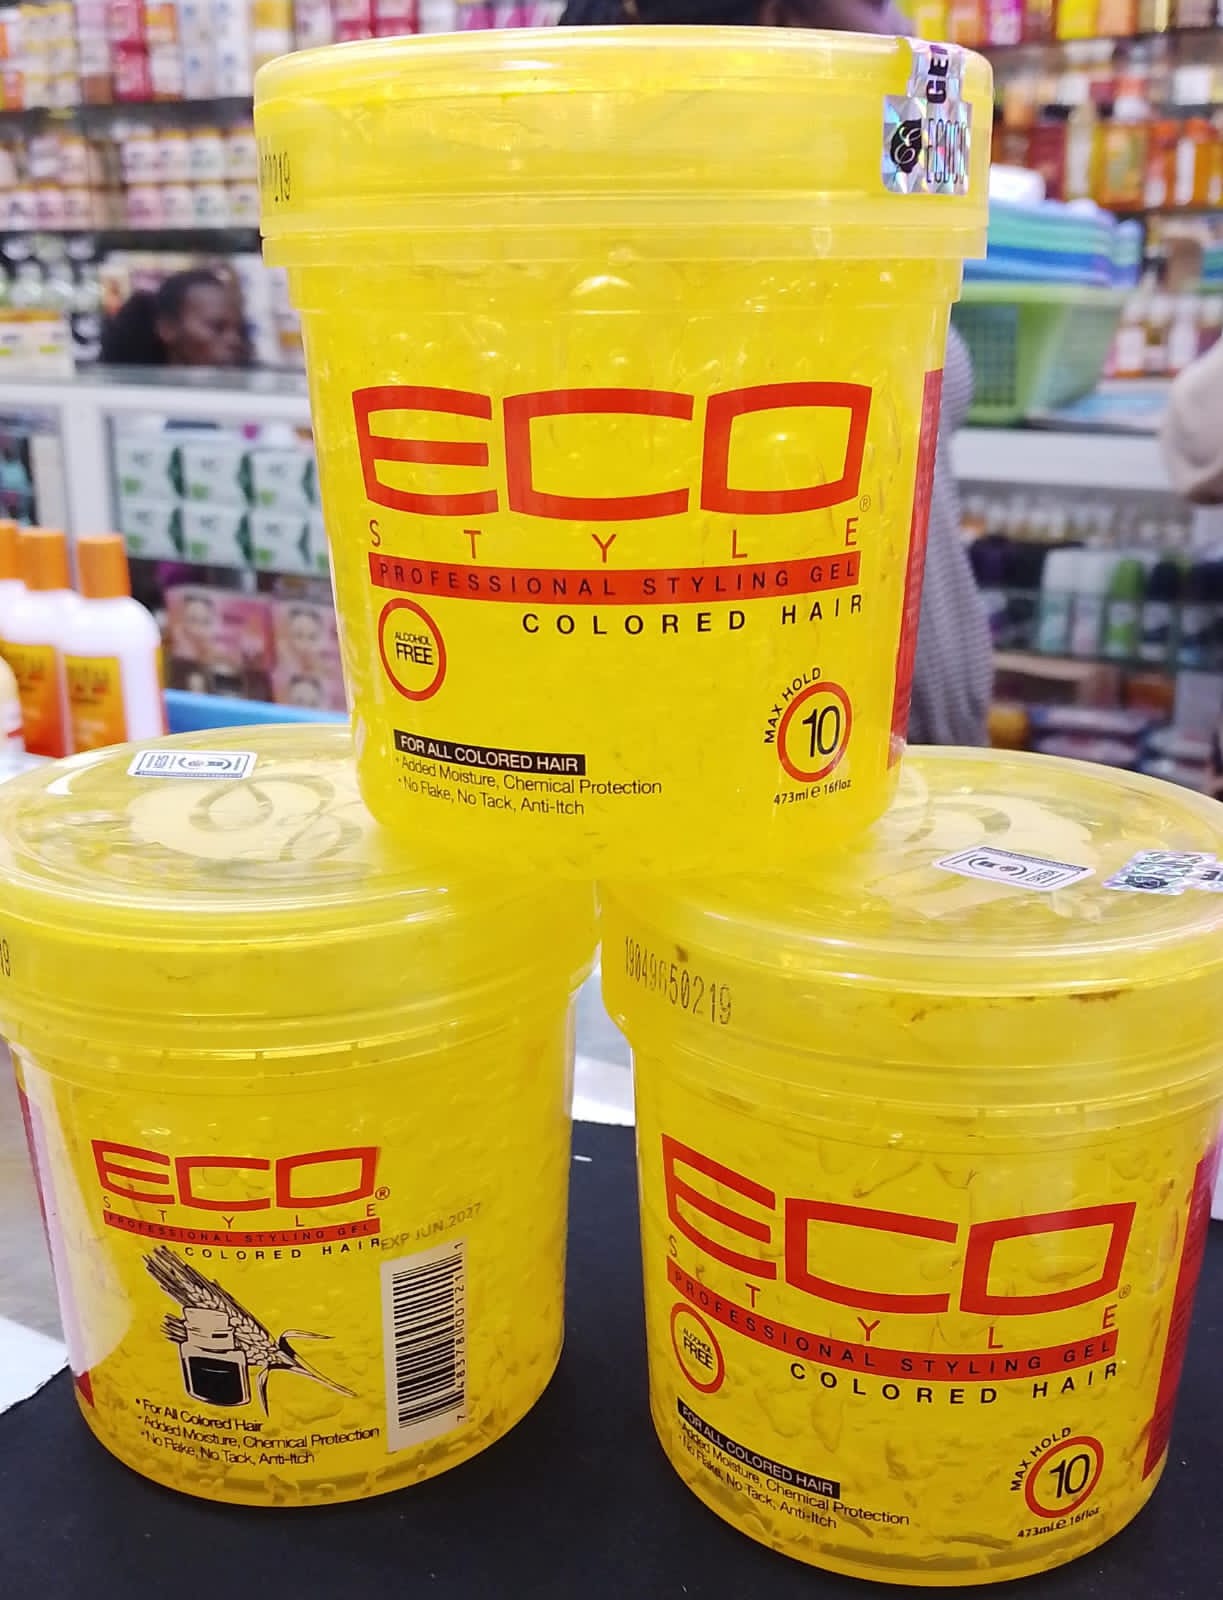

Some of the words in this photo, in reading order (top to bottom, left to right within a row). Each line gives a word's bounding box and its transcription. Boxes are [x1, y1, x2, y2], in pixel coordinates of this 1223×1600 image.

[352, 382, 873, 522] ECO
[369, 517, 859, 563] STYLE
[380, 562, 616, 596] PROFESSIONAL
[643, 570, 789, 596] STYLING
[810, 560, 855, 583] GEL
[522, 610, 746, 635] COLORED
[781, 594, 862, 624] HAIR
[395, 631, 432, 646] ALCOHOL
[396, 642, 434, 665] FREE
[764, 704, 783, 743] MAX
[782, 667, 821, 701] HOLD
[802, 705, 841, 757] 10
[400, 735, 425, 755] FOR
[427, 742, 453, 760] ALL
[455, 748, 533, 770] COLORED
[537, 756, 578, 772] HAIR
[402, 756, 437, 776] Added
[439, 763, 500, 790] Moisture,
[504, 774, 574, 794] Chemical
[579, 779, 662, 795] Protection
[404, 778, 418, 793] No
[421, 780, 454, 804] Flake,
[457, 790, 477, 806] No
[479, 792, 517, 812] Tack,
[521, 798, 585, 816] Anti-Itch
[773, 788, 809, 805] 473ml
[91, 1139, 379, 1212] ECO
[103, 1196, 376, 1229] STYLE
[108, 1214, 232, 1243] PROFESSIONAL
[245, 1230, 325, 1244] STYLING
[338, 1224, 370, 1236] GEL
[662, 1133, 1137, 1316] ECO
[185, 1246, 301, 1260] COLORED
[322, 1238, 380, 1256] HAIR
[381, 1233, 410, 1250] EXP
[668, 1234, 1118, 1349] STYLE
[674, 1270, 875, 1366] PROFESSIONAL
[901, 1356, 1041, 1375] STYLING
[1063, 1340, 1110, 1363] GEL
[683, 1328, 712, 1353] ALCOHOL
[683, 1335, 714, 1370] FREE
[790, 1363, 997, 1404] COLORED
[1033, 1363, 1117, 1398] HAIR
[143, 1399, 161, 1415] For
[164, 1406, 178, 1420] All
[180, 1410, 232, 1430] Colored
[235, 1419, 264, 1432] Hair
[144, 1416, 181, 1436] Added
[183, 1427, 241, 1449] Moisture,
[243, 1433, 307, 1448] Chemical
[312, 1427, 380, 1446] Protection
[146, 1433, 162, 1447] No
[201, 1448, 220, 1461] No
[223, 1450, 256, 1466] Tack,
[259, 1452, 315, 1465] Anti-Itch
[682, 1406, 702, 1431] FOR
[703, 1426, 725, 1448] ALL
[727, 1441, 793, 1482] COLORED
[796, 1475, 833, 1495] HAIR
[1010, 1459, 1032, 1491] MAX
[1030, 1427, 1072, 1457] HOLD
[681, 1422, 710, 1454] Added
[713, 1446, 763, 1489] Moisture,
[766, 1479, 830, 1513] Chemical
[833, 1500, 910, 1526] Protection
[681, 1435, 694, 1456] No
[726, 1474, 743, 1491] No
[746, 1485, 777, 1511] Tack,
[780, 1501, 837, 1528] Anti-Itch
[1049, 1453, 1090, 1498] 10
[1017, 1521, 1054, 1539] 473ml
